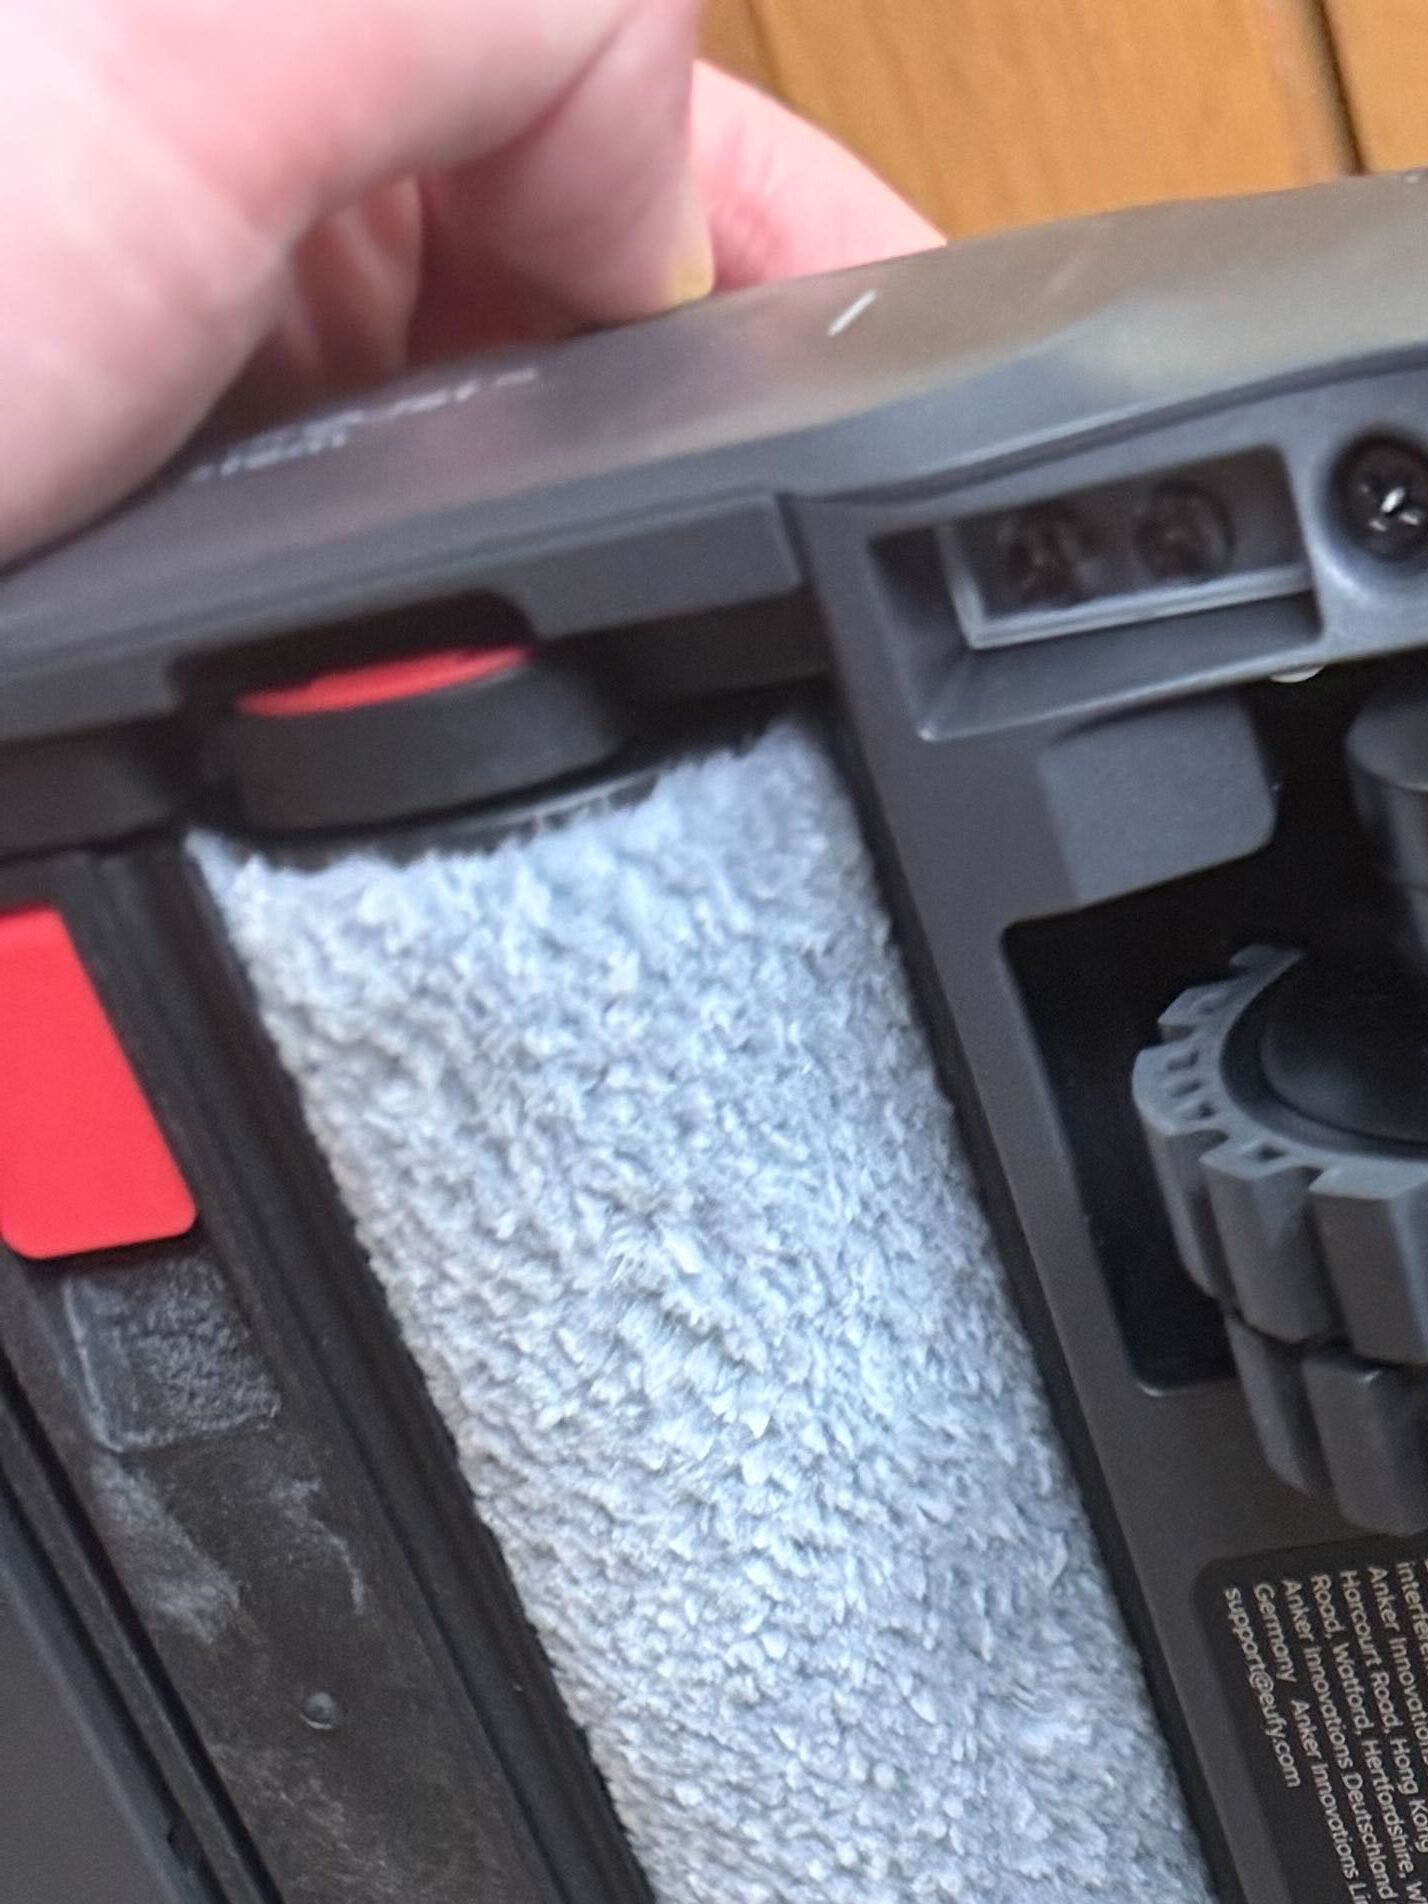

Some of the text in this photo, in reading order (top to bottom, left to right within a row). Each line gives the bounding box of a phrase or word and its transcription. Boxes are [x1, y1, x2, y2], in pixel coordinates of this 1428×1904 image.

[1223, 1586, 1302, 1788] support@eufy.com
[1367, 1565, 1400, 1631] Anker
[1252, 1582, 1297, 1683] Germany
[1289, 1698, 1323, 1759] Anker
[1309, 1761, 1360, 1880] Innovations
[1281, 1579, 1315, 1642] Anker
[1302, 1645, 1354, 1770] Innovations
[1340, 1771, 1399, 1900] Deutschland
